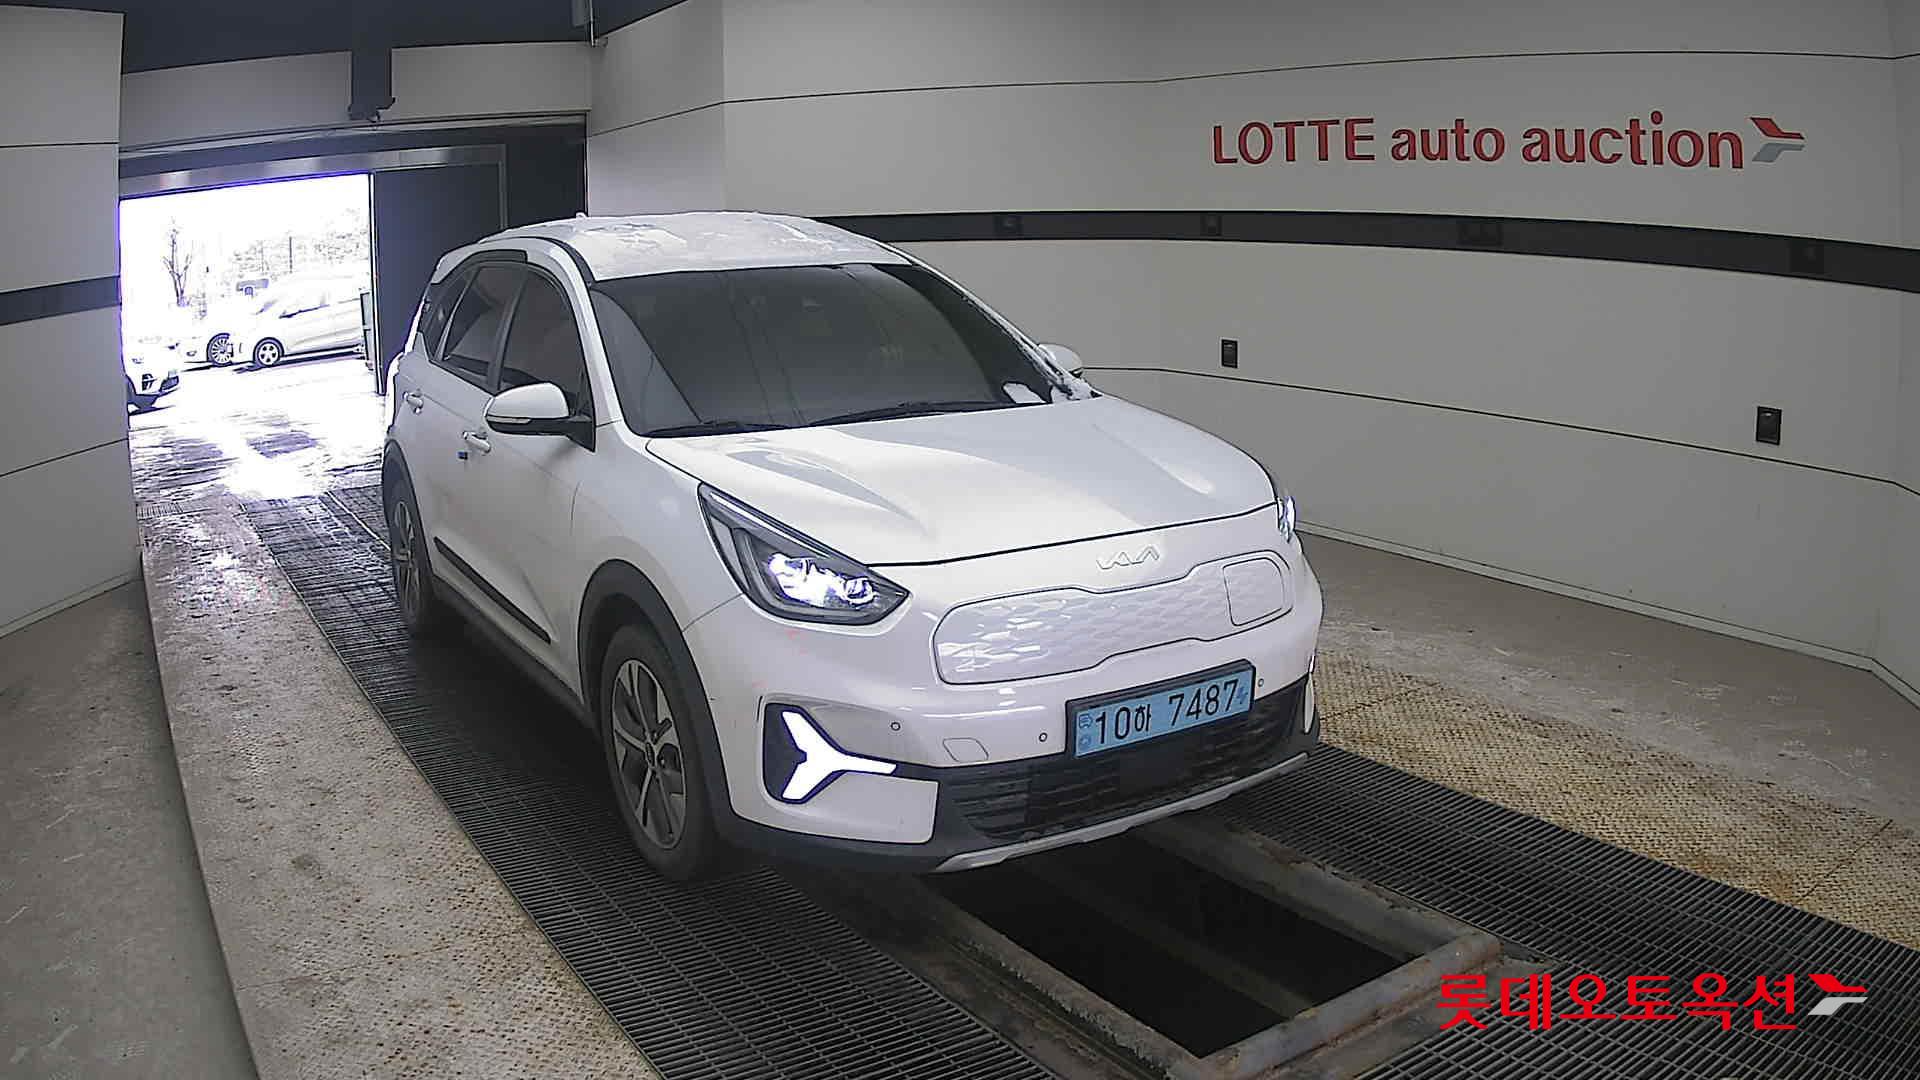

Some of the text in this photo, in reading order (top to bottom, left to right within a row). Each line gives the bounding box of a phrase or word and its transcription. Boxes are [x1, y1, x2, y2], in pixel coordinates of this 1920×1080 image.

[1212, 110, 1744, 170] LOTTE auto auction
[1095, 678, 1239, 745] 10하 7487
